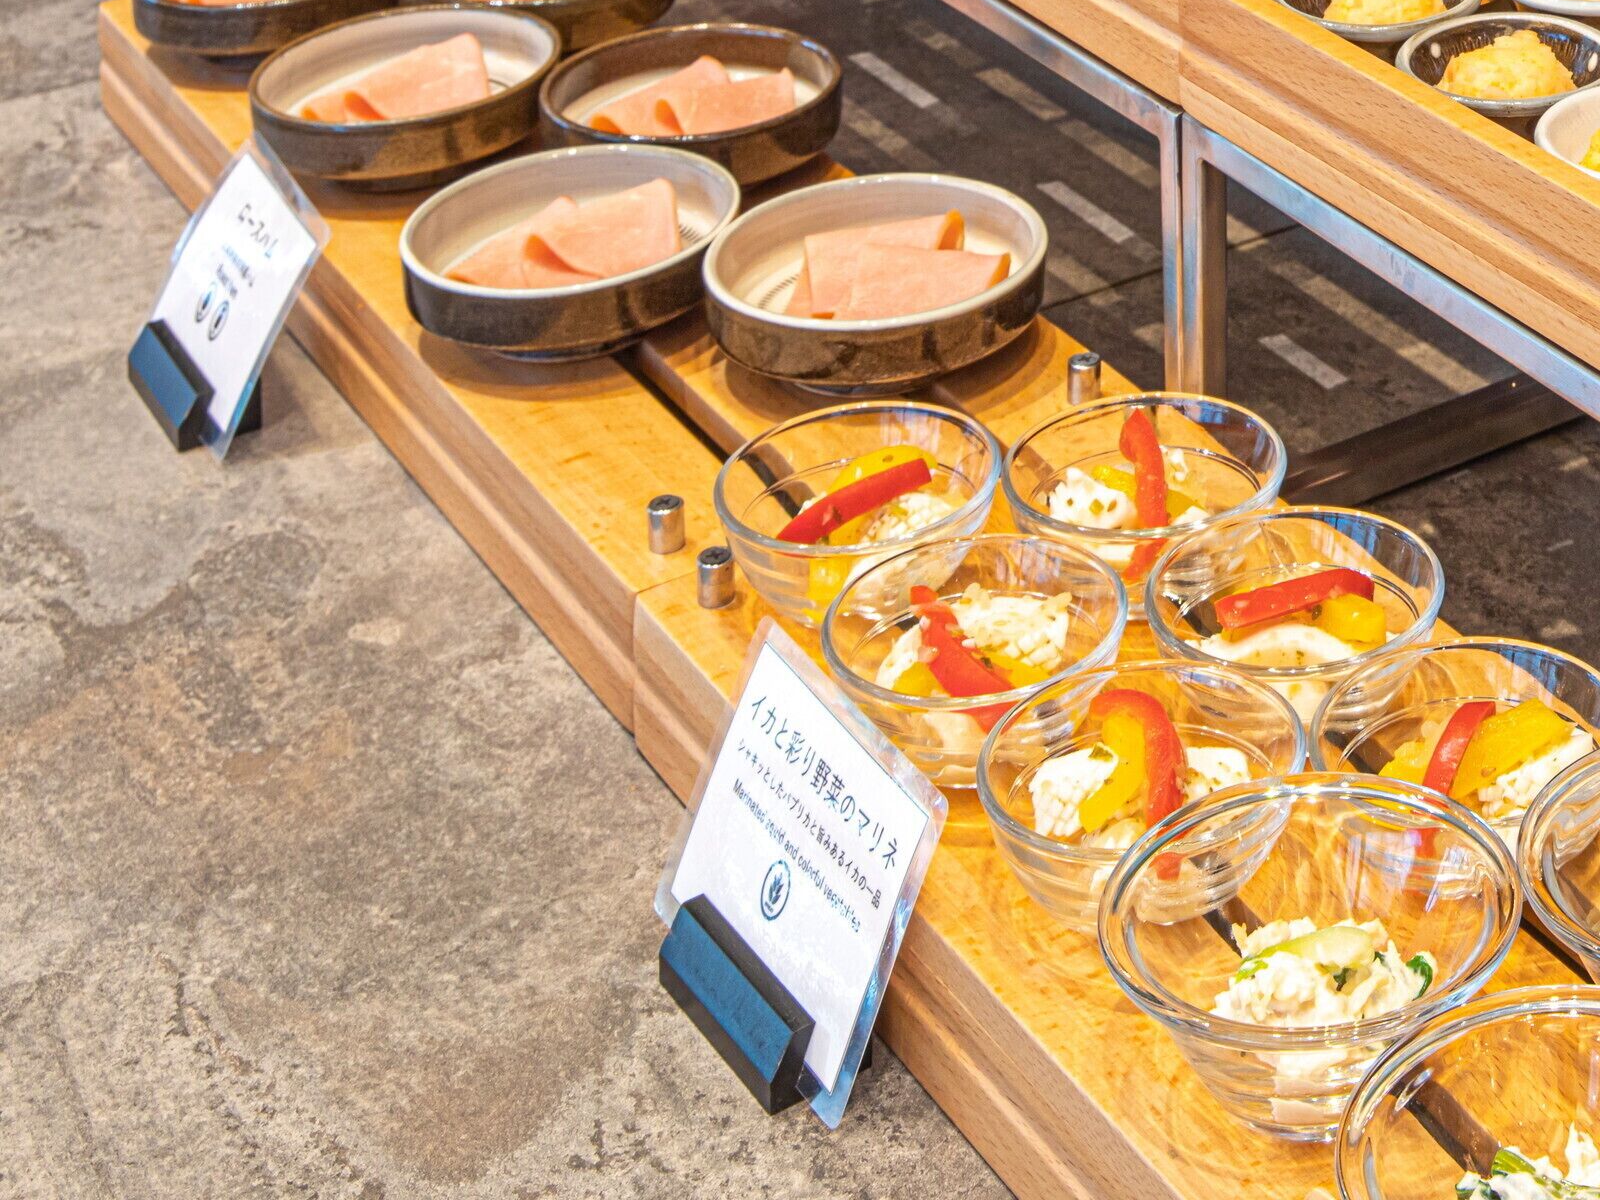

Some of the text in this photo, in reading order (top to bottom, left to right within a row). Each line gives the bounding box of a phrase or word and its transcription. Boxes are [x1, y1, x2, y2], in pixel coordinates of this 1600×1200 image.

[732, 777, 768, 824] Marinated
[783, 839, 800, 861] and
[797, 855, 826, 890] colorful
[738, 738, 881, 910] シャキッとしたパプリカと旨みあるイカの一品
[751, 696, 898, 870] イカと彩り野菜のマリネ
